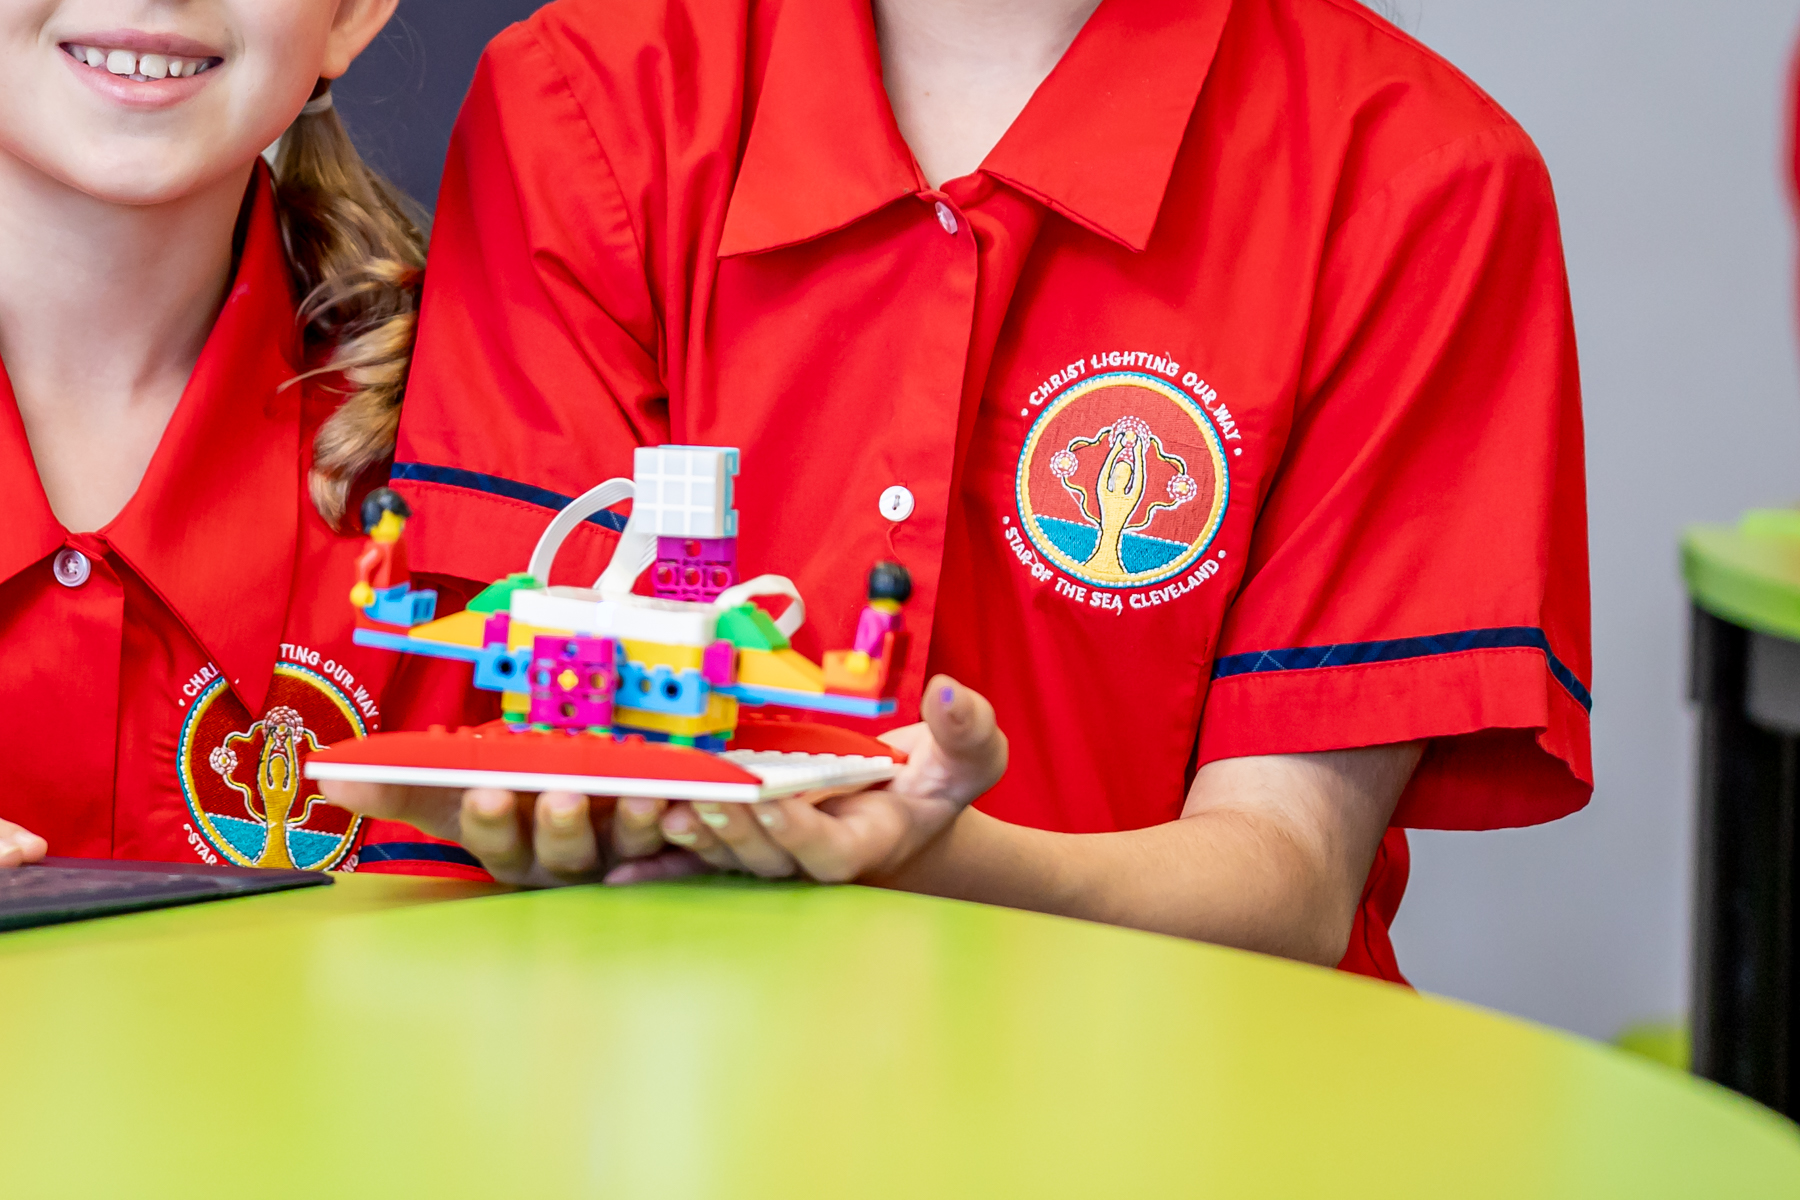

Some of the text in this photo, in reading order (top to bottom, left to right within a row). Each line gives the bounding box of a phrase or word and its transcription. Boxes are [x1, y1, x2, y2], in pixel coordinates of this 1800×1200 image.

[1029, 351, 1241, 440] CHRIST LIGHTING OUR WAY
[1005, 526, 1219, 612] STAR OF THE SEA CLEVELAND
[182, 643, 379, 718] CHRI TING OUR WAY
[187, 832, 218, 866] STAR
